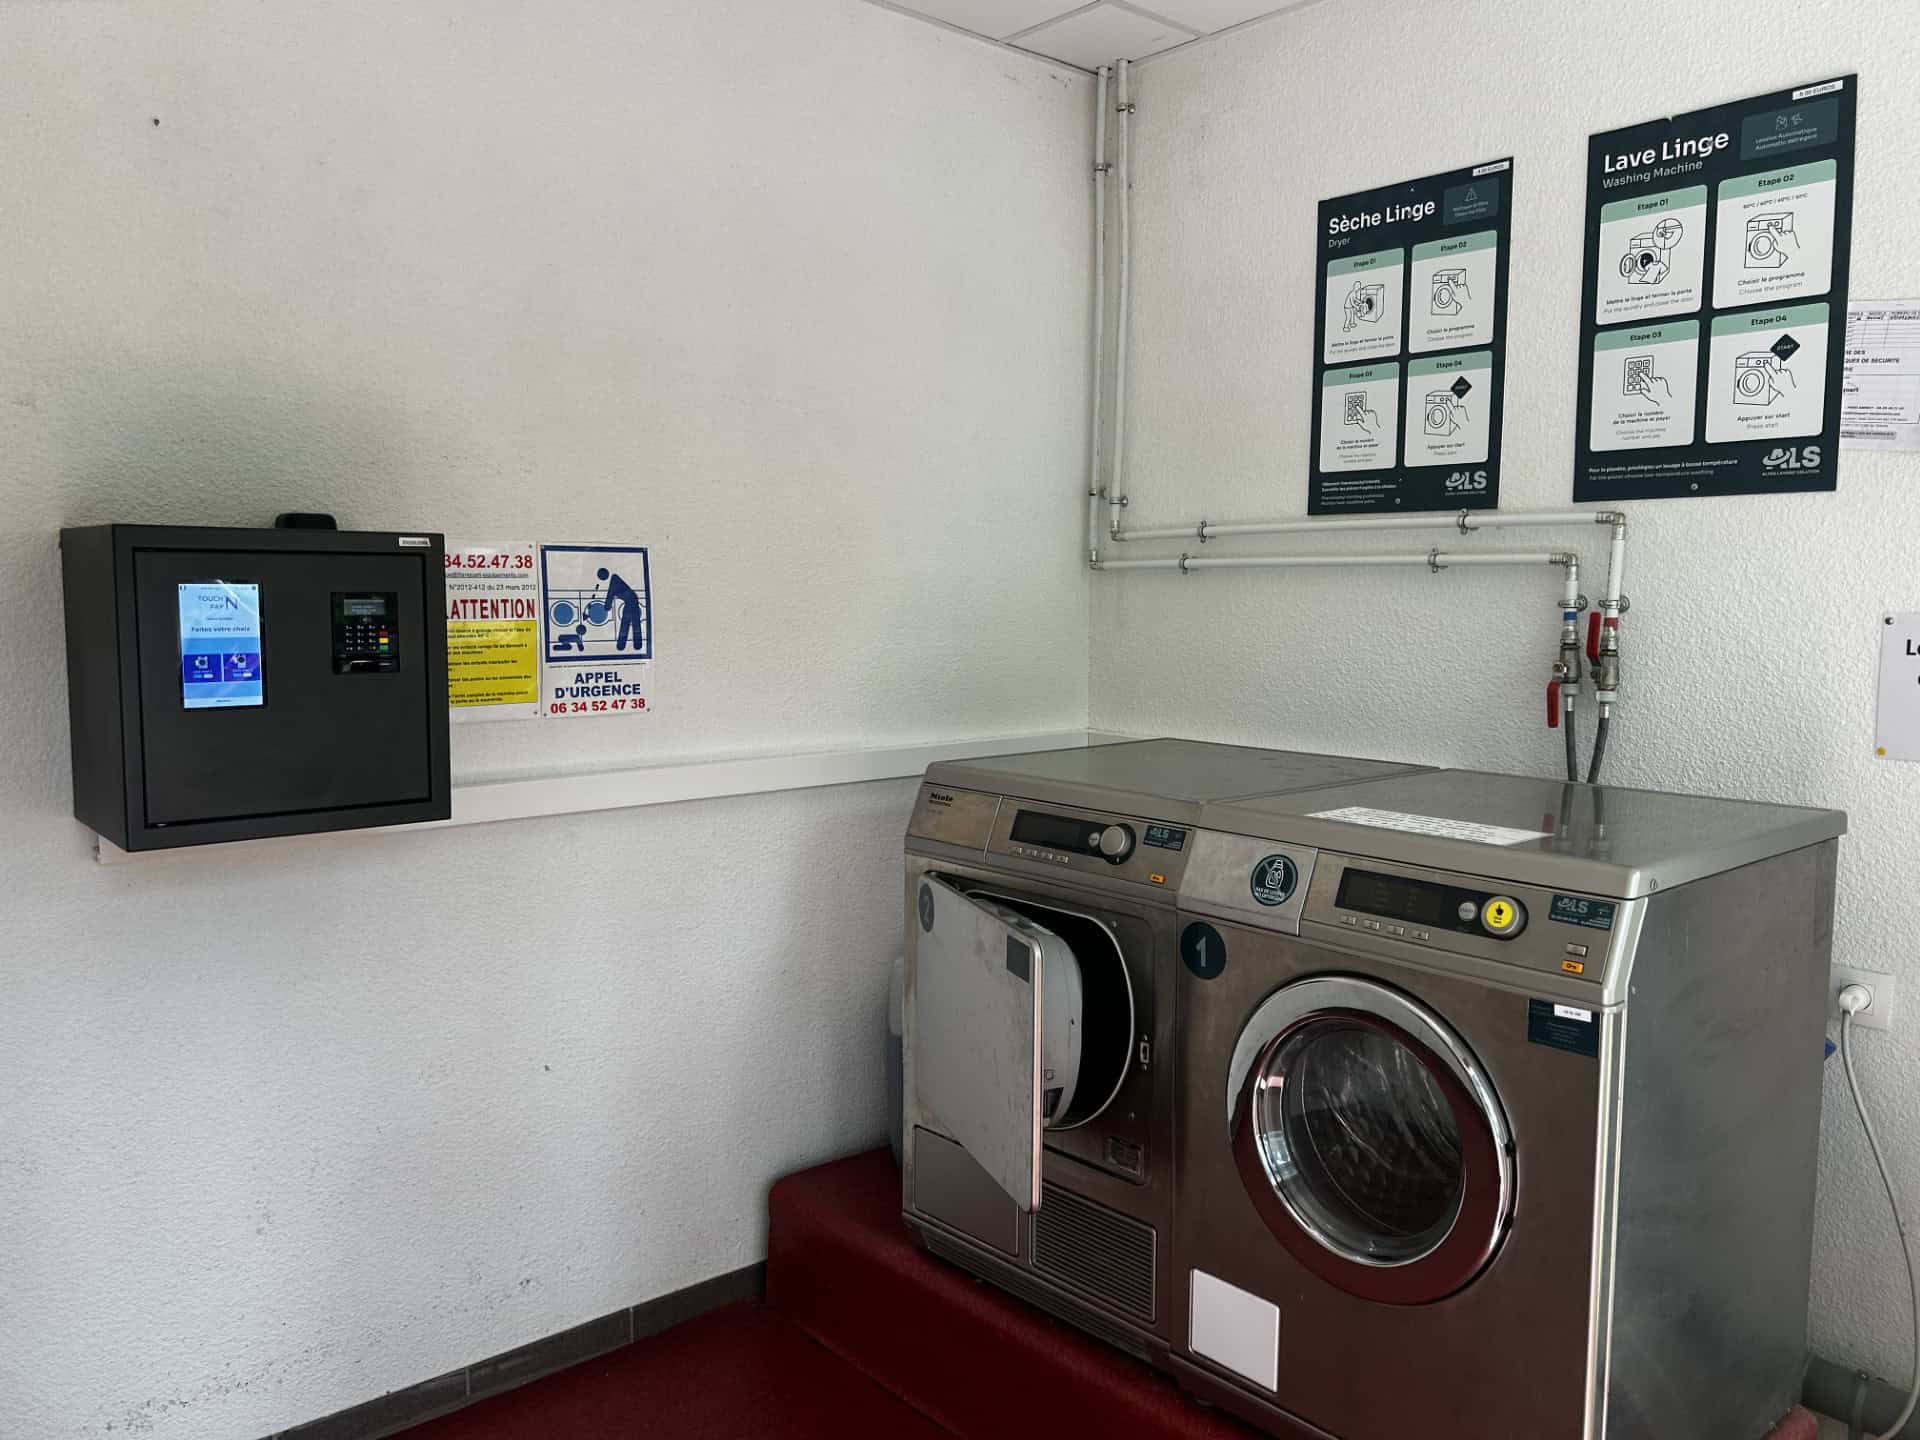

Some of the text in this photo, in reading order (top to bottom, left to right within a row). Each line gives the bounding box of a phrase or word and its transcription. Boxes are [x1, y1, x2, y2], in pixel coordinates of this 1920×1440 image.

[1604, 132, 1729, 174] Lave Linge
[1603, 161, 1703, 189] Washing Machine
[1758, 175, 1795, 188] Etape 02
[1637, 198, 1669, 211] Etape 01
[1328, 211, 1381, 235] Sèche
[1385, 200, 1435, 223] Linge
[1328, 236, 1351, 249] Dryer
[1751, 314, 1787, 326] Etape 04
[1630, 331, 1662, 342] Etape 03
[495, 583, 505, 591] 23
[521, 583, 536, 591] 2012
[225, 596, 239, 609] N
[451, 599, 536, 619] ATTENTION
[574, 671, 622, 685] APPEL
[555, 683, 641, 699] D'URGENCE
[551, 698, 646, 714] 06 34 52 47 38
[1195, 935, 1207, 968] 1
